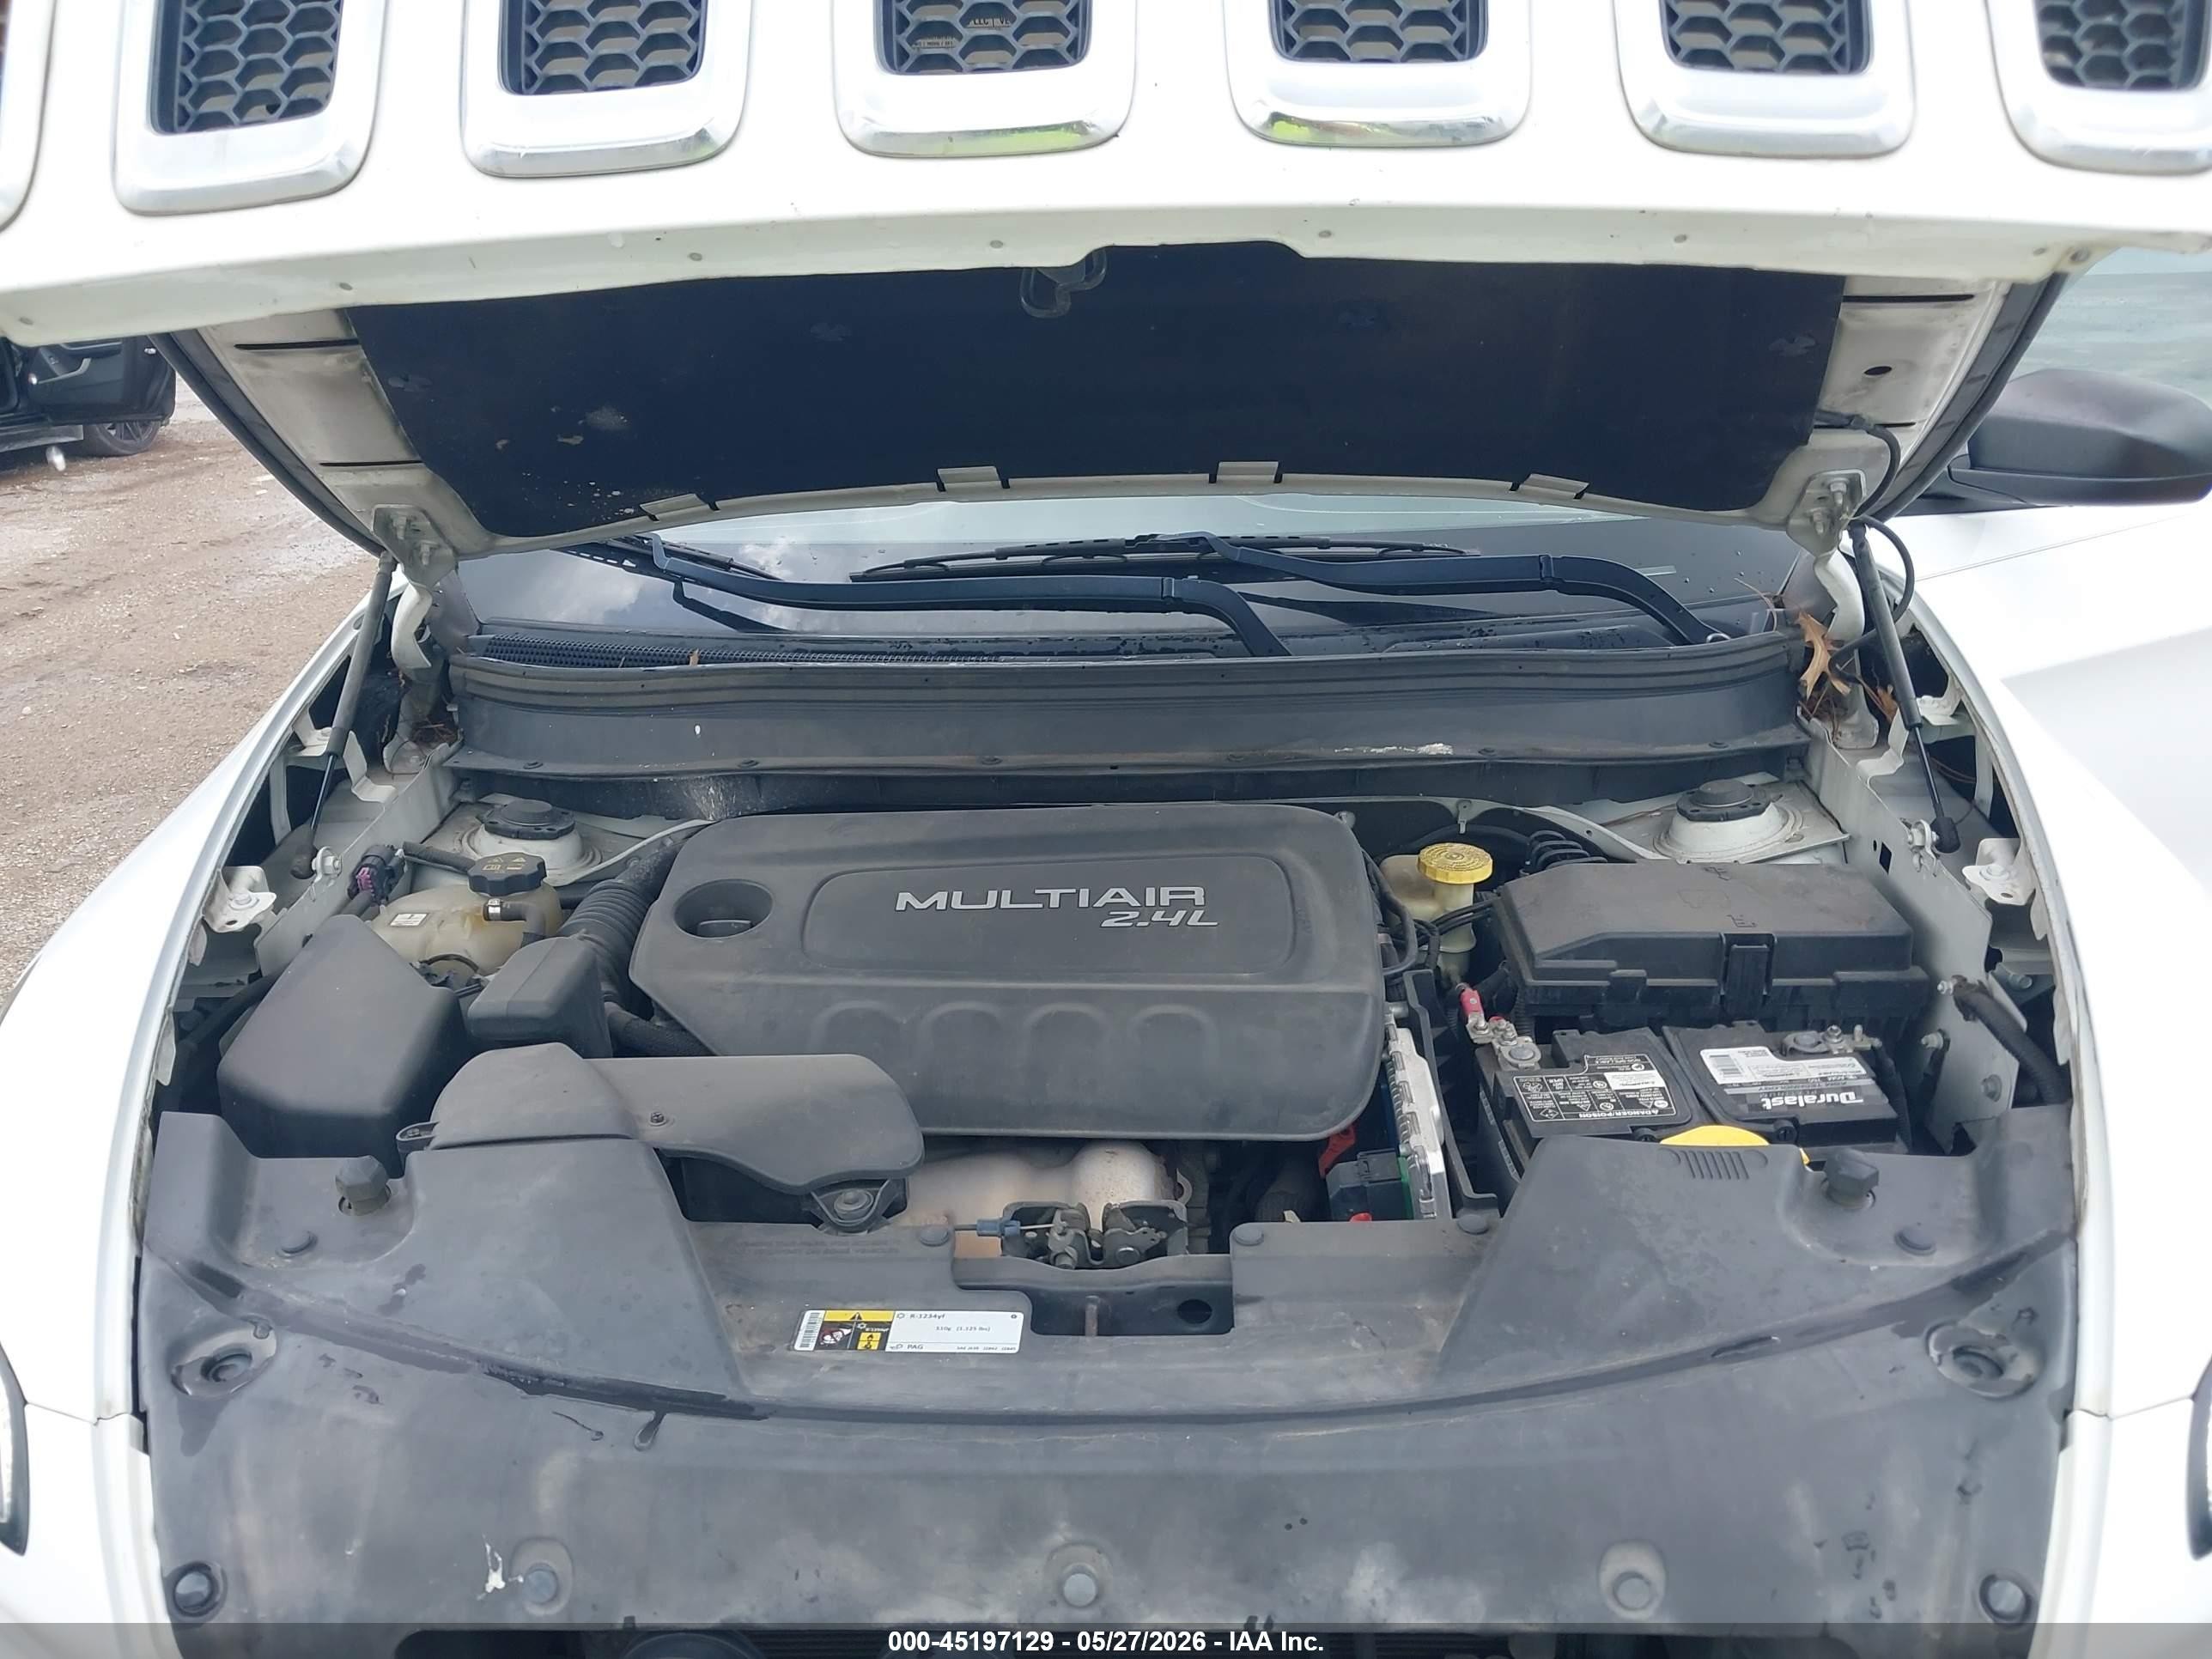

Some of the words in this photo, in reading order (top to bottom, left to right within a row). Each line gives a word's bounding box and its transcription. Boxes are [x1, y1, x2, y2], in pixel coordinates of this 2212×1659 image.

[895, 885, 1206, 911] MULTIAIR
[1100, 908, 1219, 928] 2.4L
[1760, 1091, 1864, 1110] Duralast
